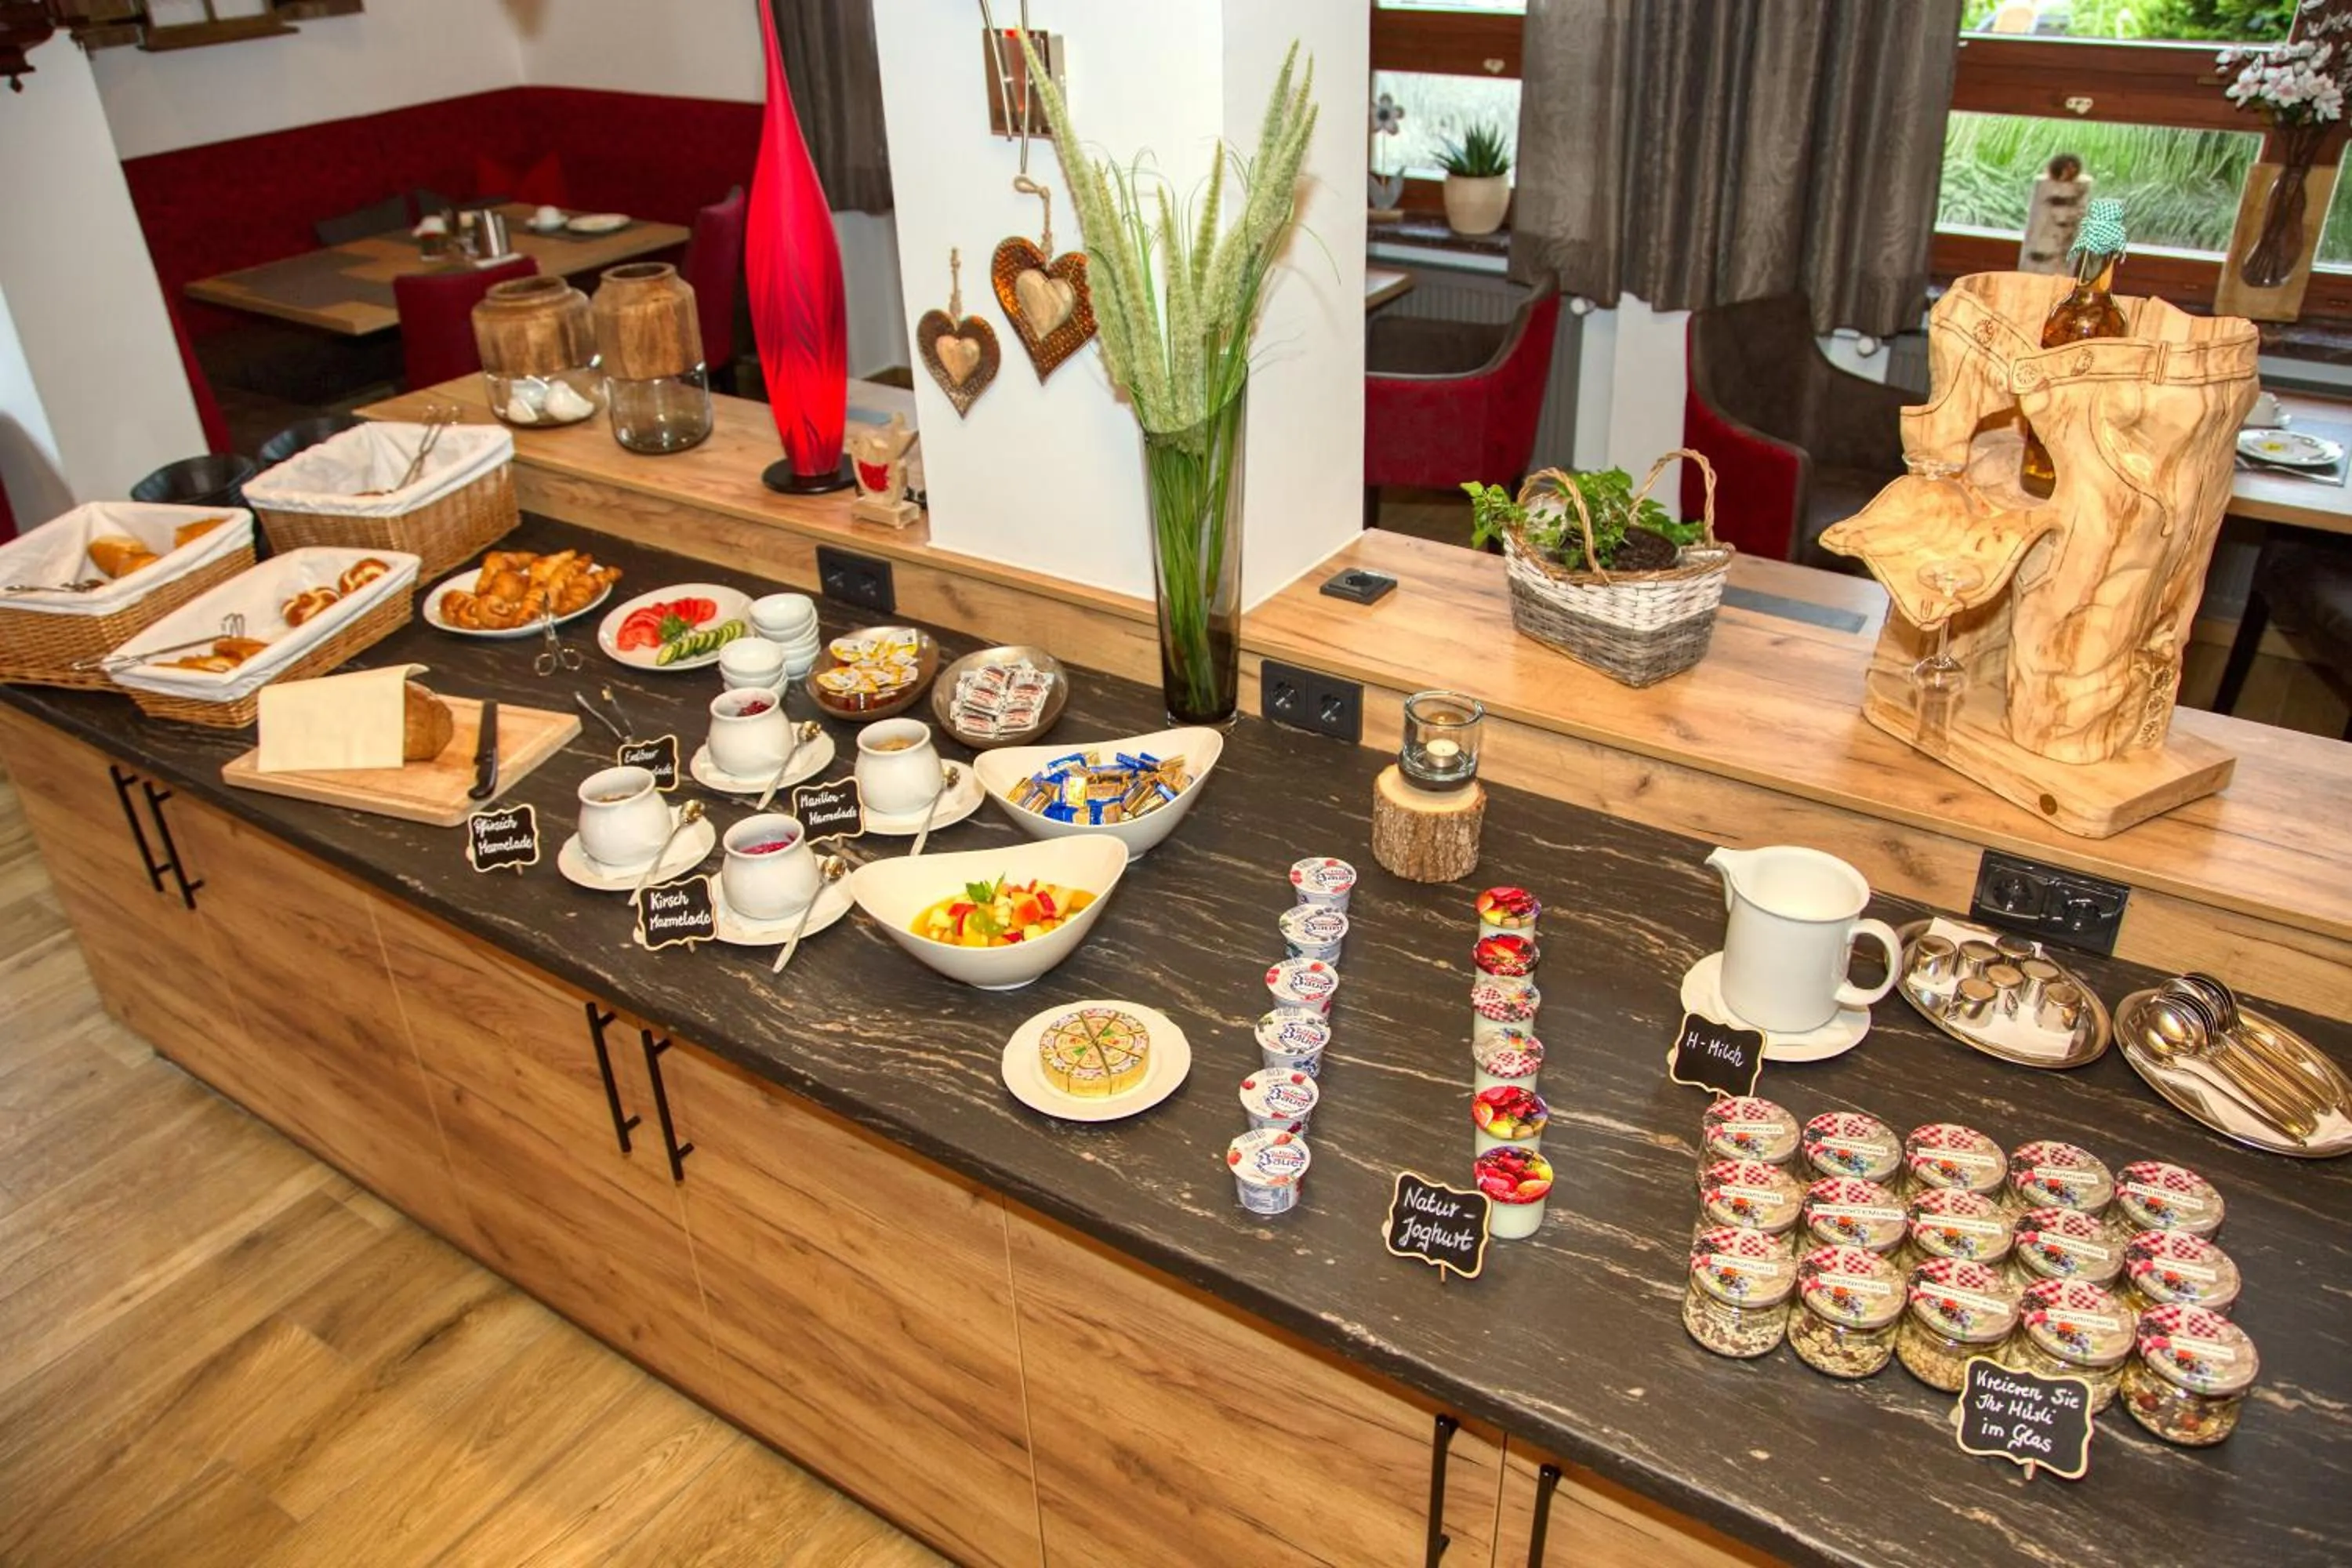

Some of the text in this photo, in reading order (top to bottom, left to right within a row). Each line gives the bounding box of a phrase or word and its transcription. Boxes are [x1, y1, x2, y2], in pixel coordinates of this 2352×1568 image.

[649, 891, 689, 911] Kirsch
[649, 910, 711, 931] Marmelade
[1398, 1214, 1475, 1253] Joghurt
[1976, 1370, 2080, 1409] Kreieren Sie
[1981, 1417, 2053, 1453] im Glas
